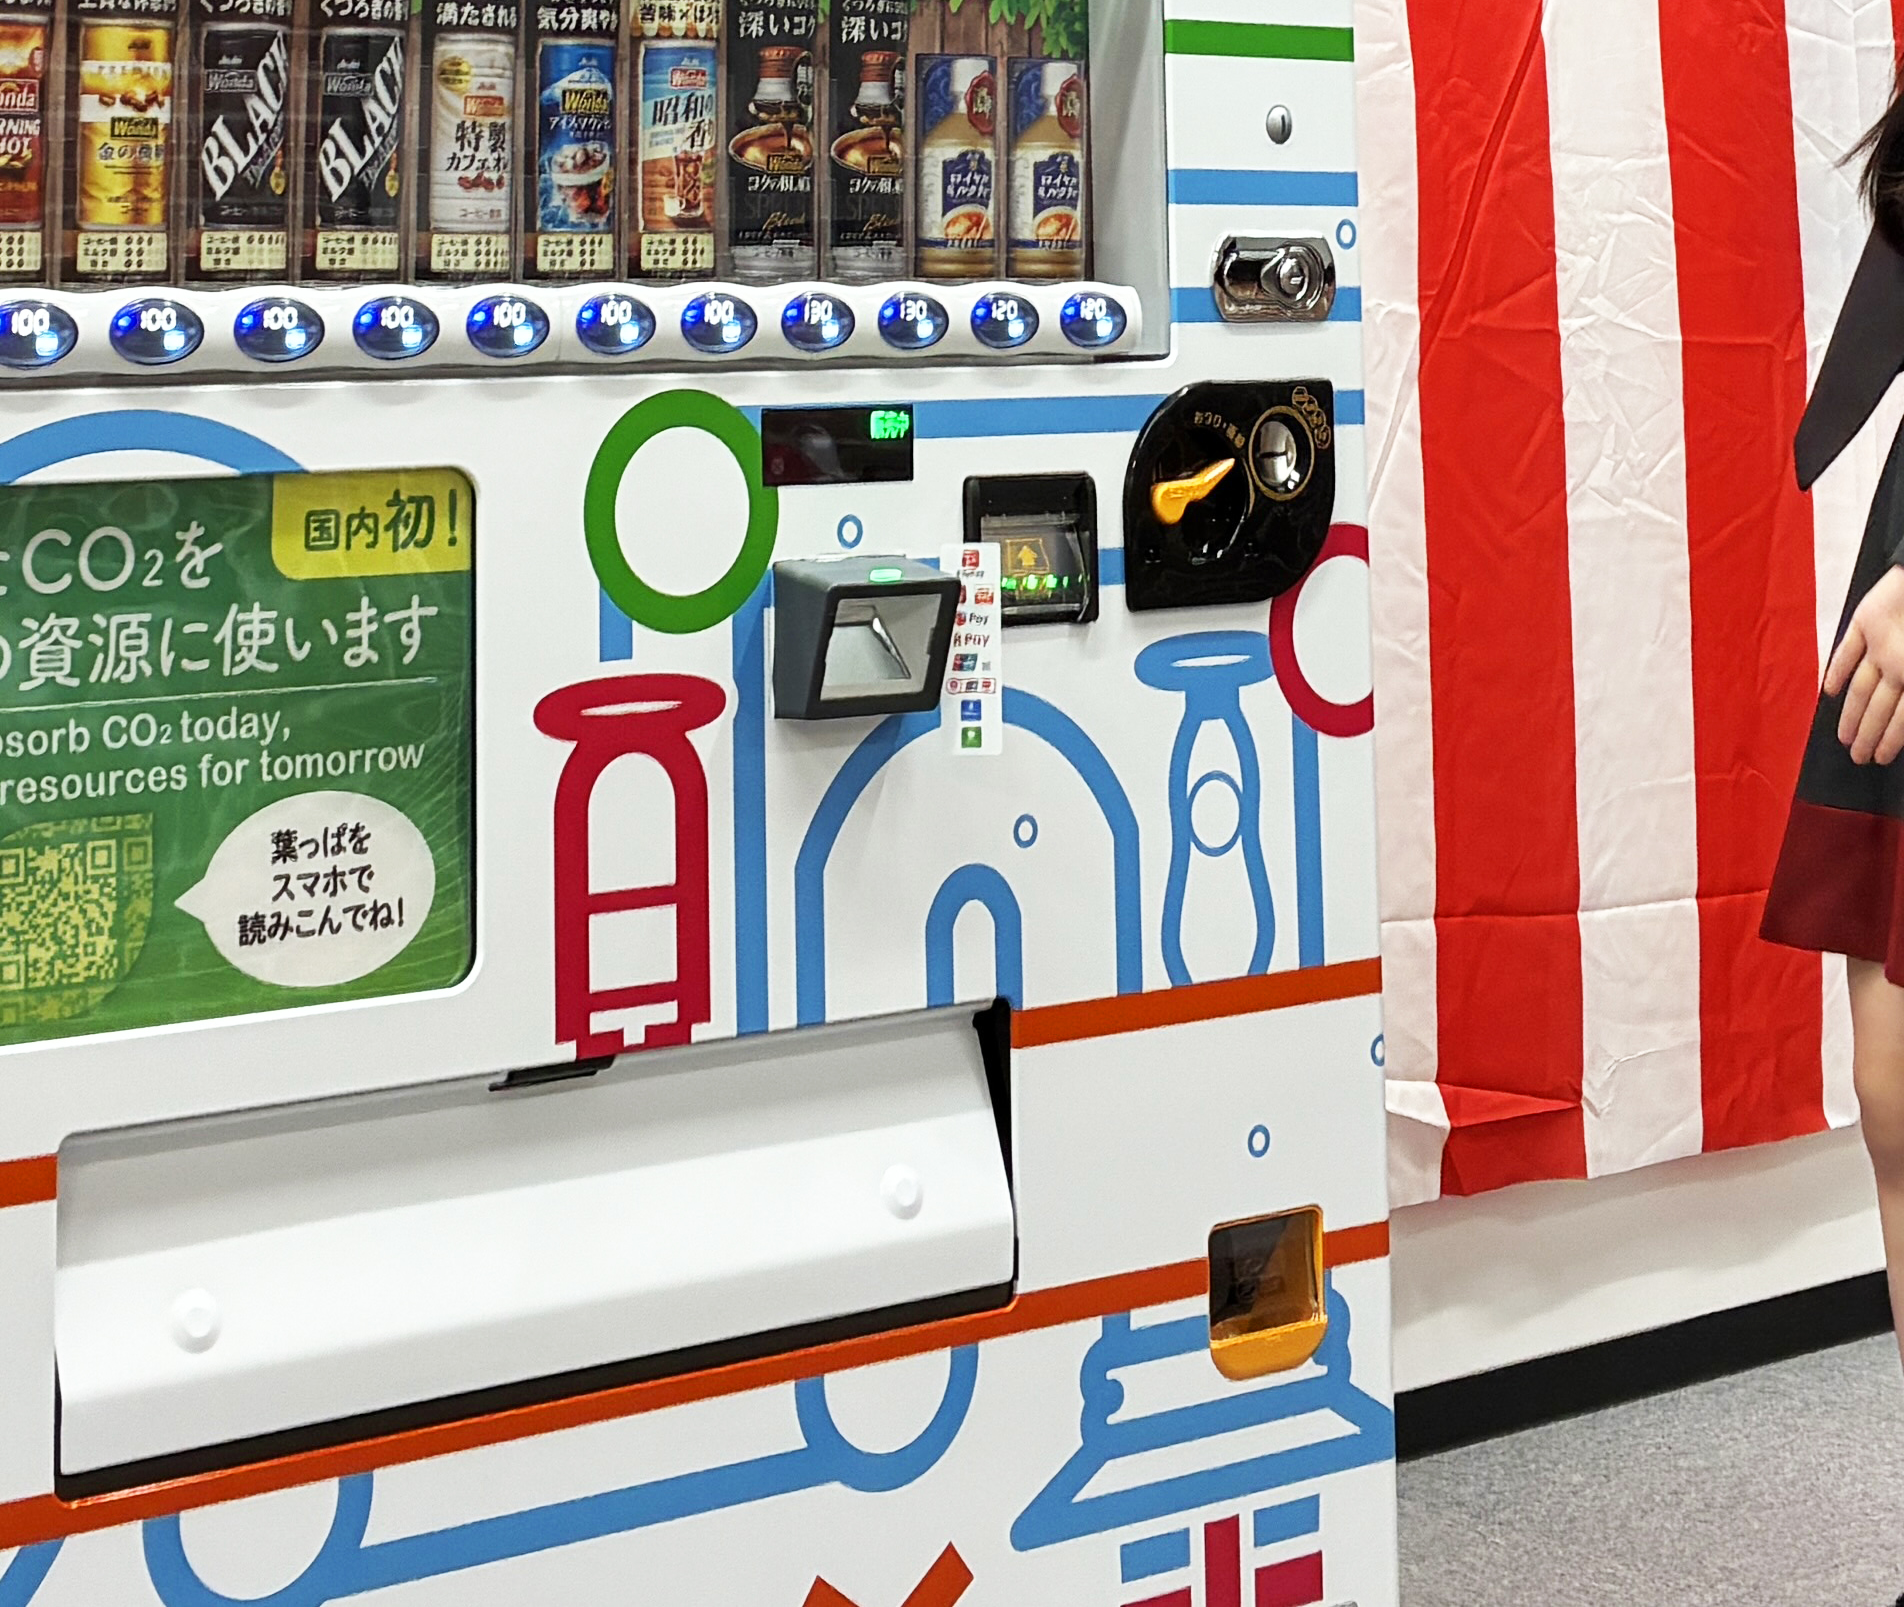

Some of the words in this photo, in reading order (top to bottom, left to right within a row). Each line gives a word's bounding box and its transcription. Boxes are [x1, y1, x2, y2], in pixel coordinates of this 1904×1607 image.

[201, 29, 288, 201] BLACK
[12, 308, 50, 336] 100
[139, 305, 177, 332] 100
[262, 305, 298, 331] 100
[380, 304, 415, 330] 100
[493, 301, 526, 328] 100
[600, 300, 632, 326] 100
[702, 300, 734, 326] 100
[804, 300, 833, 325] 130
[899, 299, 928, 322] 130
[991, 299, 1018, 322] 120
[302, 487, 459, 554] 国内初!
[102, 711, 174, 751] CO2
[180, 705, 292, 746] today,
[199, 752, 247, 786] for
[259, 743, 426, 784] tomorrow
[269, 821, 371, 866] 葉っぱを
[272, 861, 375, 904] スマホで
[237, 896, 406, 948] 読みこんでね!
